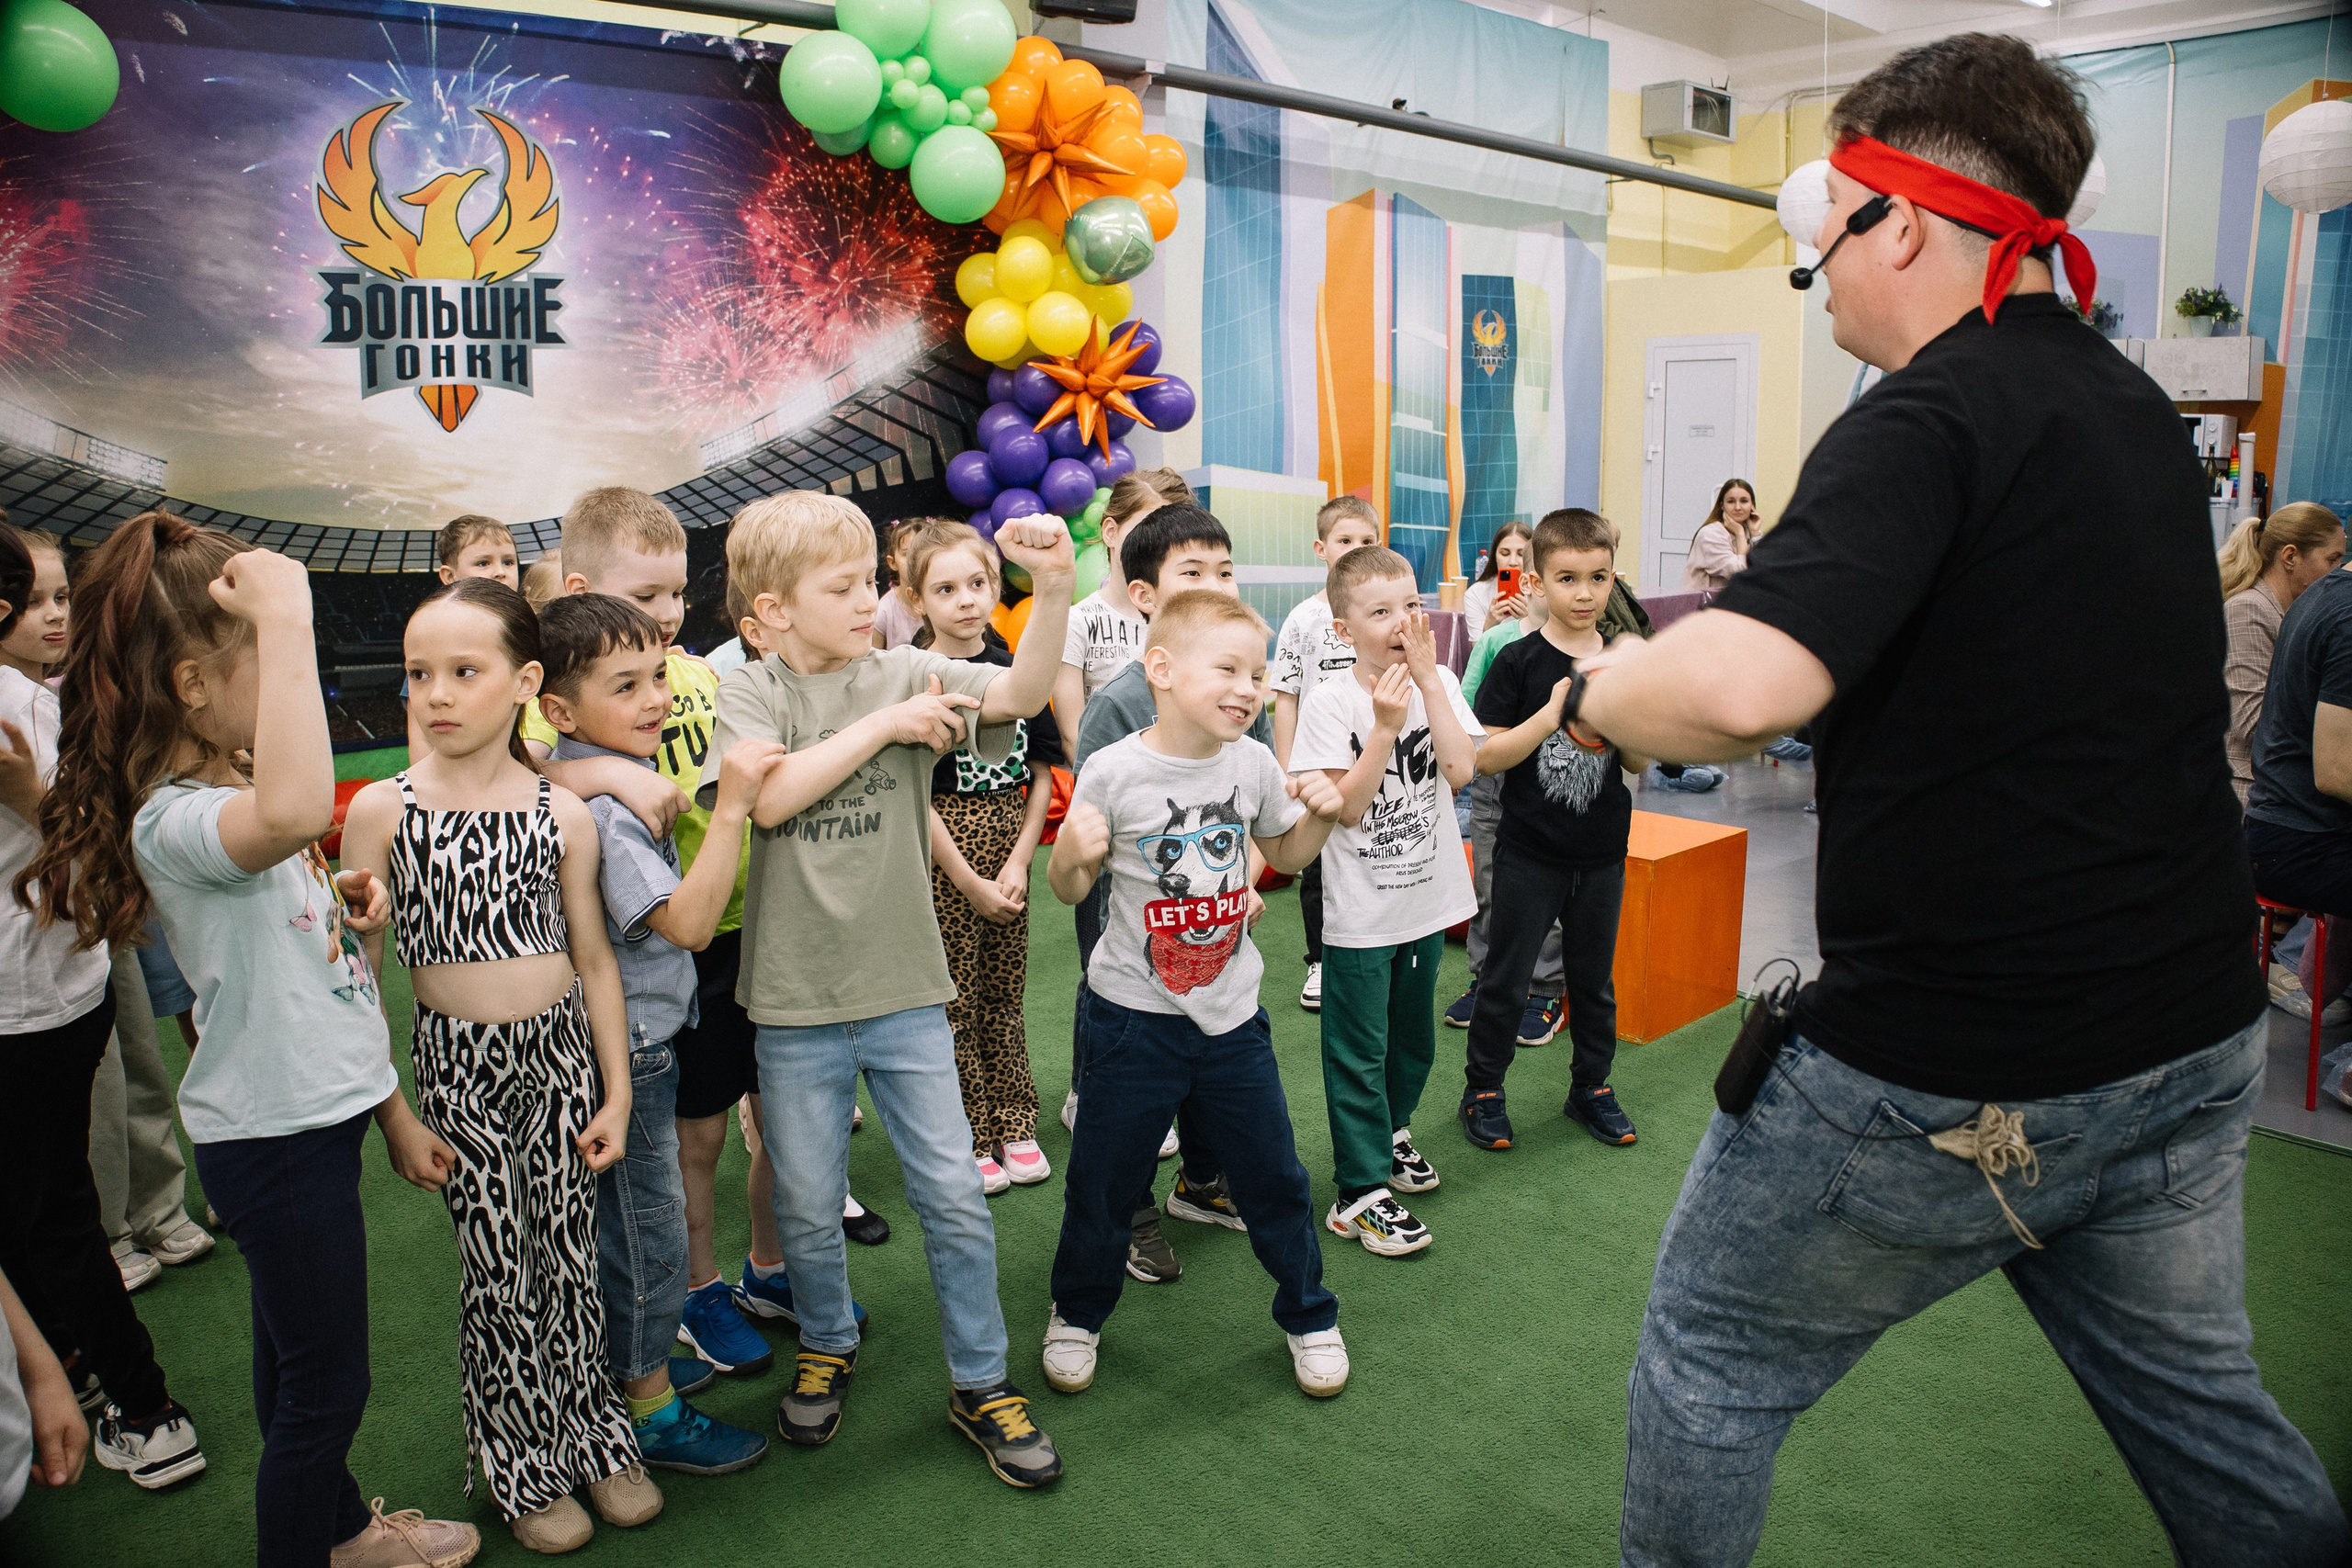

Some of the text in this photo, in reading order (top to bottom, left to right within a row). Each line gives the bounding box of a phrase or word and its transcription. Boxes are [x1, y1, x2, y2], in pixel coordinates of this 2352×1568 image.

[318, 272, 567, 344] БОЛЬШИЕ
[1473, 343, 1508, 358] БОЛЬШИЕ
[366, 343, 529, 389] ГОНКИ
[1477, 357, 1503, 367] ГОНКИ
[839, 796, 865, 809] THE
[1369, 843, 1404, 859] AUTHOR
[1216, 890, 1249, 919] PLAY
